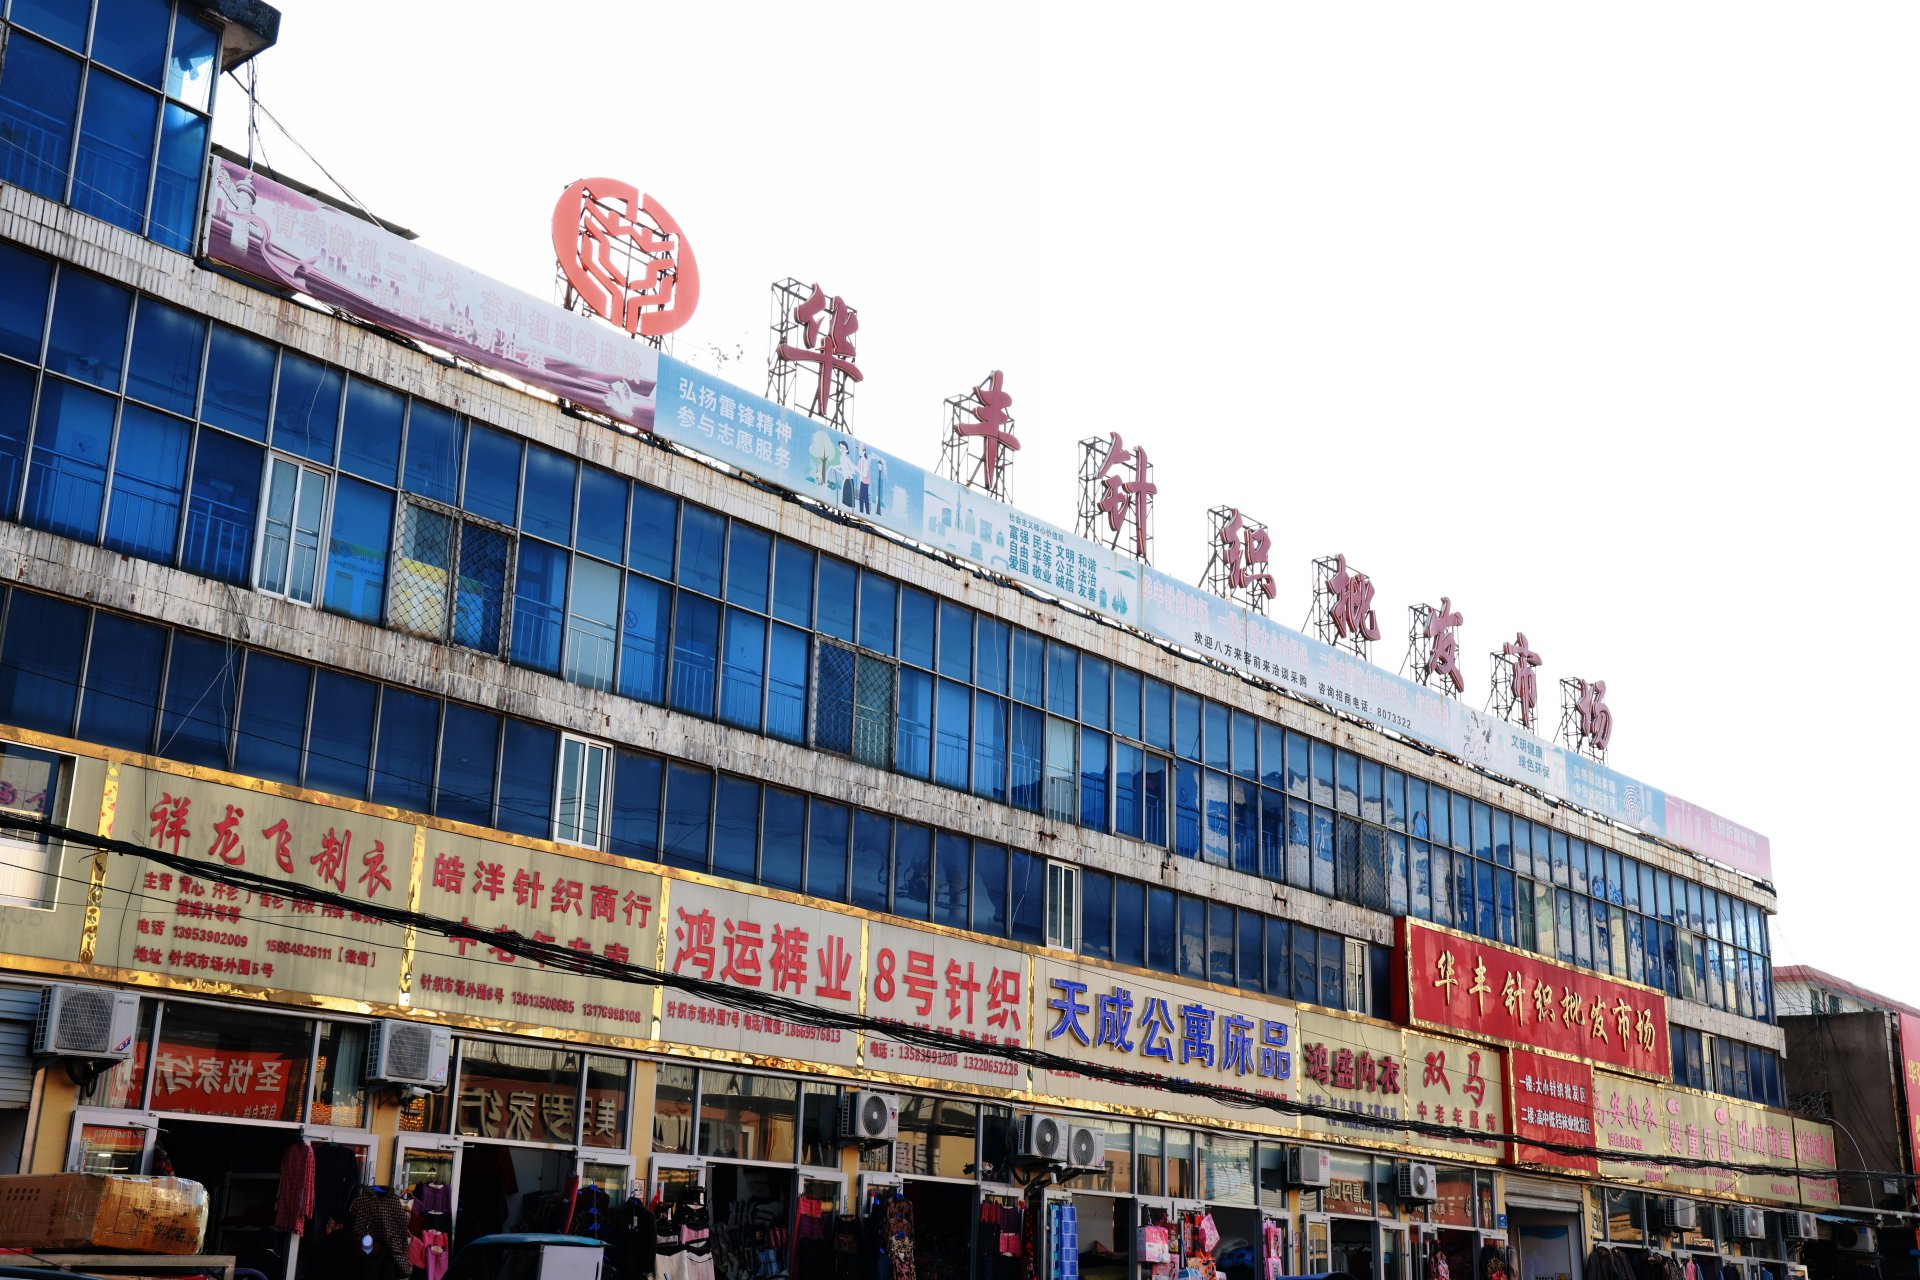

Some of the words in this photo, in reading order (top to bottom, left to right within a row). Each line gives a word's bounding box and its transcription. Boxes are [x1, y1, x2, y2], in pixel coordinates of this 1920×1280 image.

[272, 203, 459, 305] 青春献礼二十大
[677, 405, 791, 470] 参与志愿服务
[678, 377, 792, 444] 弘扬雷锋精神
[779, 283, 1612, 750] 华丰针织批发市场
[1009, 525, 1029, 545] 富强
[1033, 535, 1052, 555] 民主
[1056, 545, 1075, 564] 文明
[1078, 553, 1096, 573] 和谐
[1010, 541, 1028, 559] 自由
[1032, 549, 1052, 569] 平等
[1056, 560, 1074, 579] 公正
[1078, 568, 1096, 588] 法治
[1009, 555, 1028, 575] 爱国
[1032, 564, 1052, 584] 敬业
[1055, 574, 1074, 593] 诚信
[1078, 583, 1096, 602] 友善
[1194, 631, 1307, 689] 欢迎八方来客前来洽谈采购
[1511, 734, 1543, 760] 文明健康
[1518, 755, 1550, 779] 绿色环保
[150, 791, 393, 898] 祥龙飞制衣
[144, 871, 173, 892] 主营
[179, 875, 206, 897] 背心
[432, 852, 653, 929] 皓洋针织商行
[133, 945, 162, 966] 地址
[137, 918, 165, 936] 电话
[172, 925, 248, 948] 13953902009
[266, 939, 332, 961] 15864826111
[673, 904, 853, 1002] 鸿运裤业
[874, 946, 1022, 1033] 8号针织
[1434, 950, 1656, 1053] 华丰针织批发市场
[1047, 977, 1292, 1080] 天成公寓床品
[963, 1055, 1019, 1076] 13220652228
[1304, 1042, 1401, 1095] 鸿盛内衣
[1422, 1050, 1487, 1108] 双马
[1416, 1101, 1496, 1132] 中老年服饰
[1668, 1119, 1731, 1162] 婴童乐园
